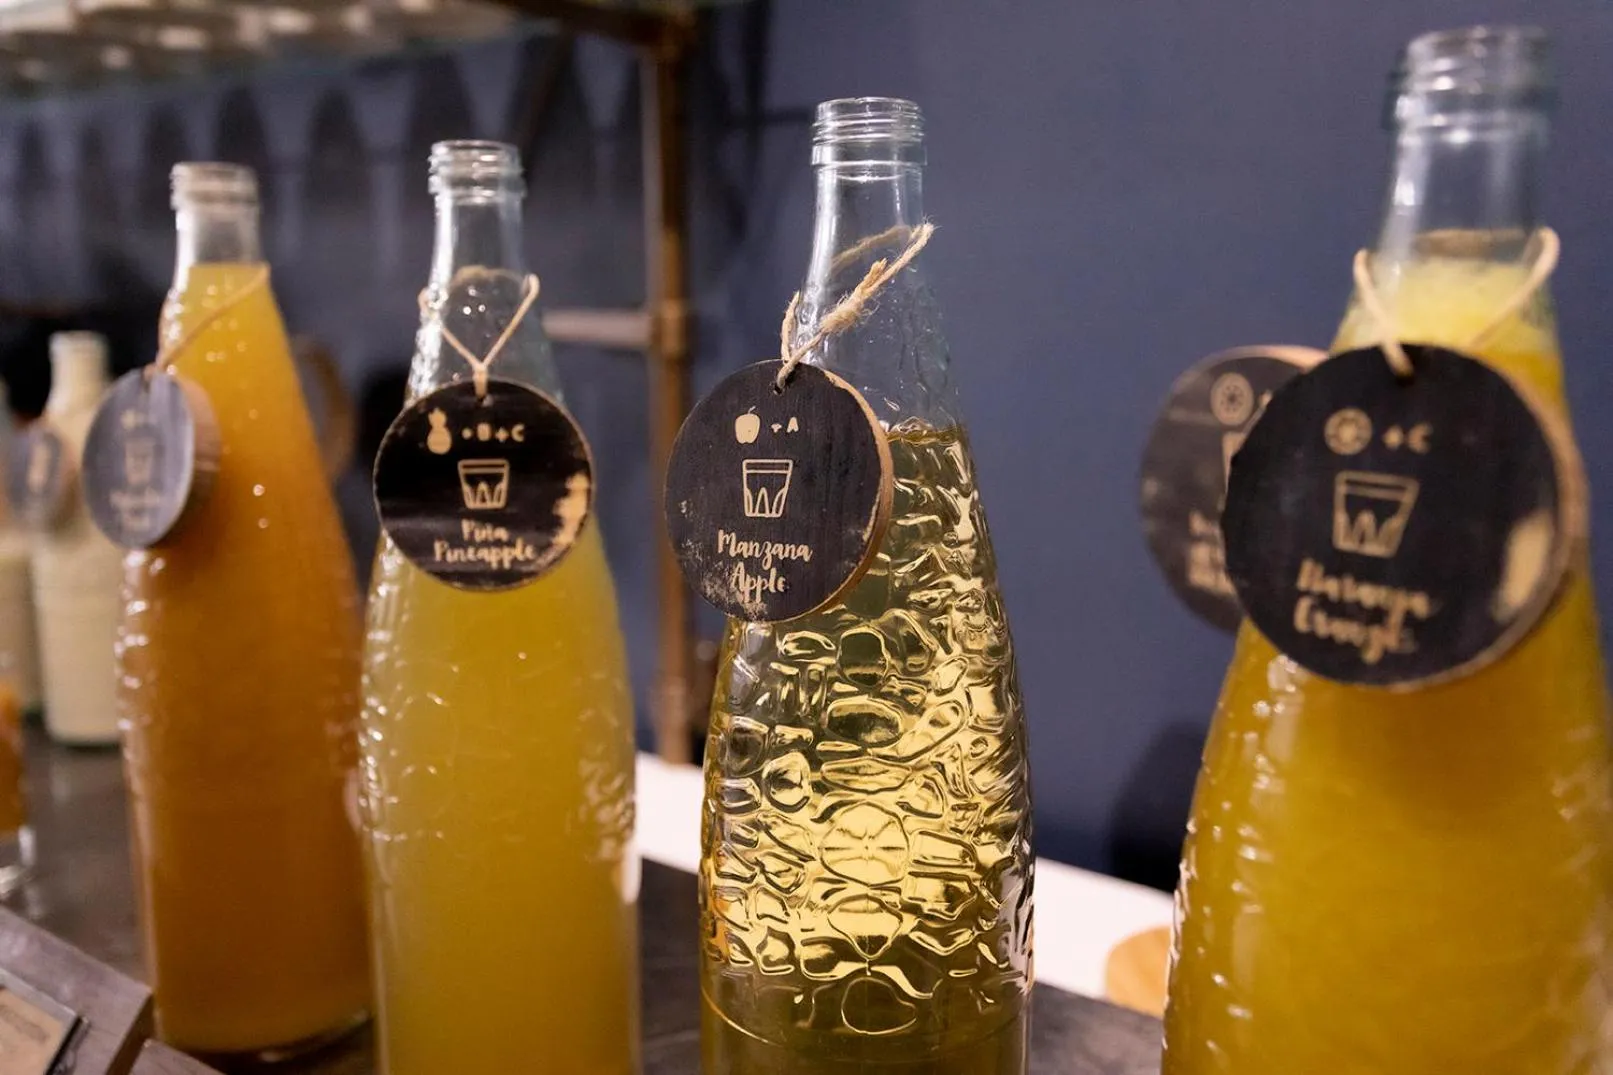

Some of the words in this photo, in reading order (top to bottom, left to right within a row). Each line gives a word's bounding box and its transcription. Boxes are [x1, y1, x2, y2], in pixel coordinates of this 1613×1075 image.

[433, 537, 535, 569] Pineapple
[717, 529, 813, 570] Manzana
[729, 561, 786, 604] Apple
